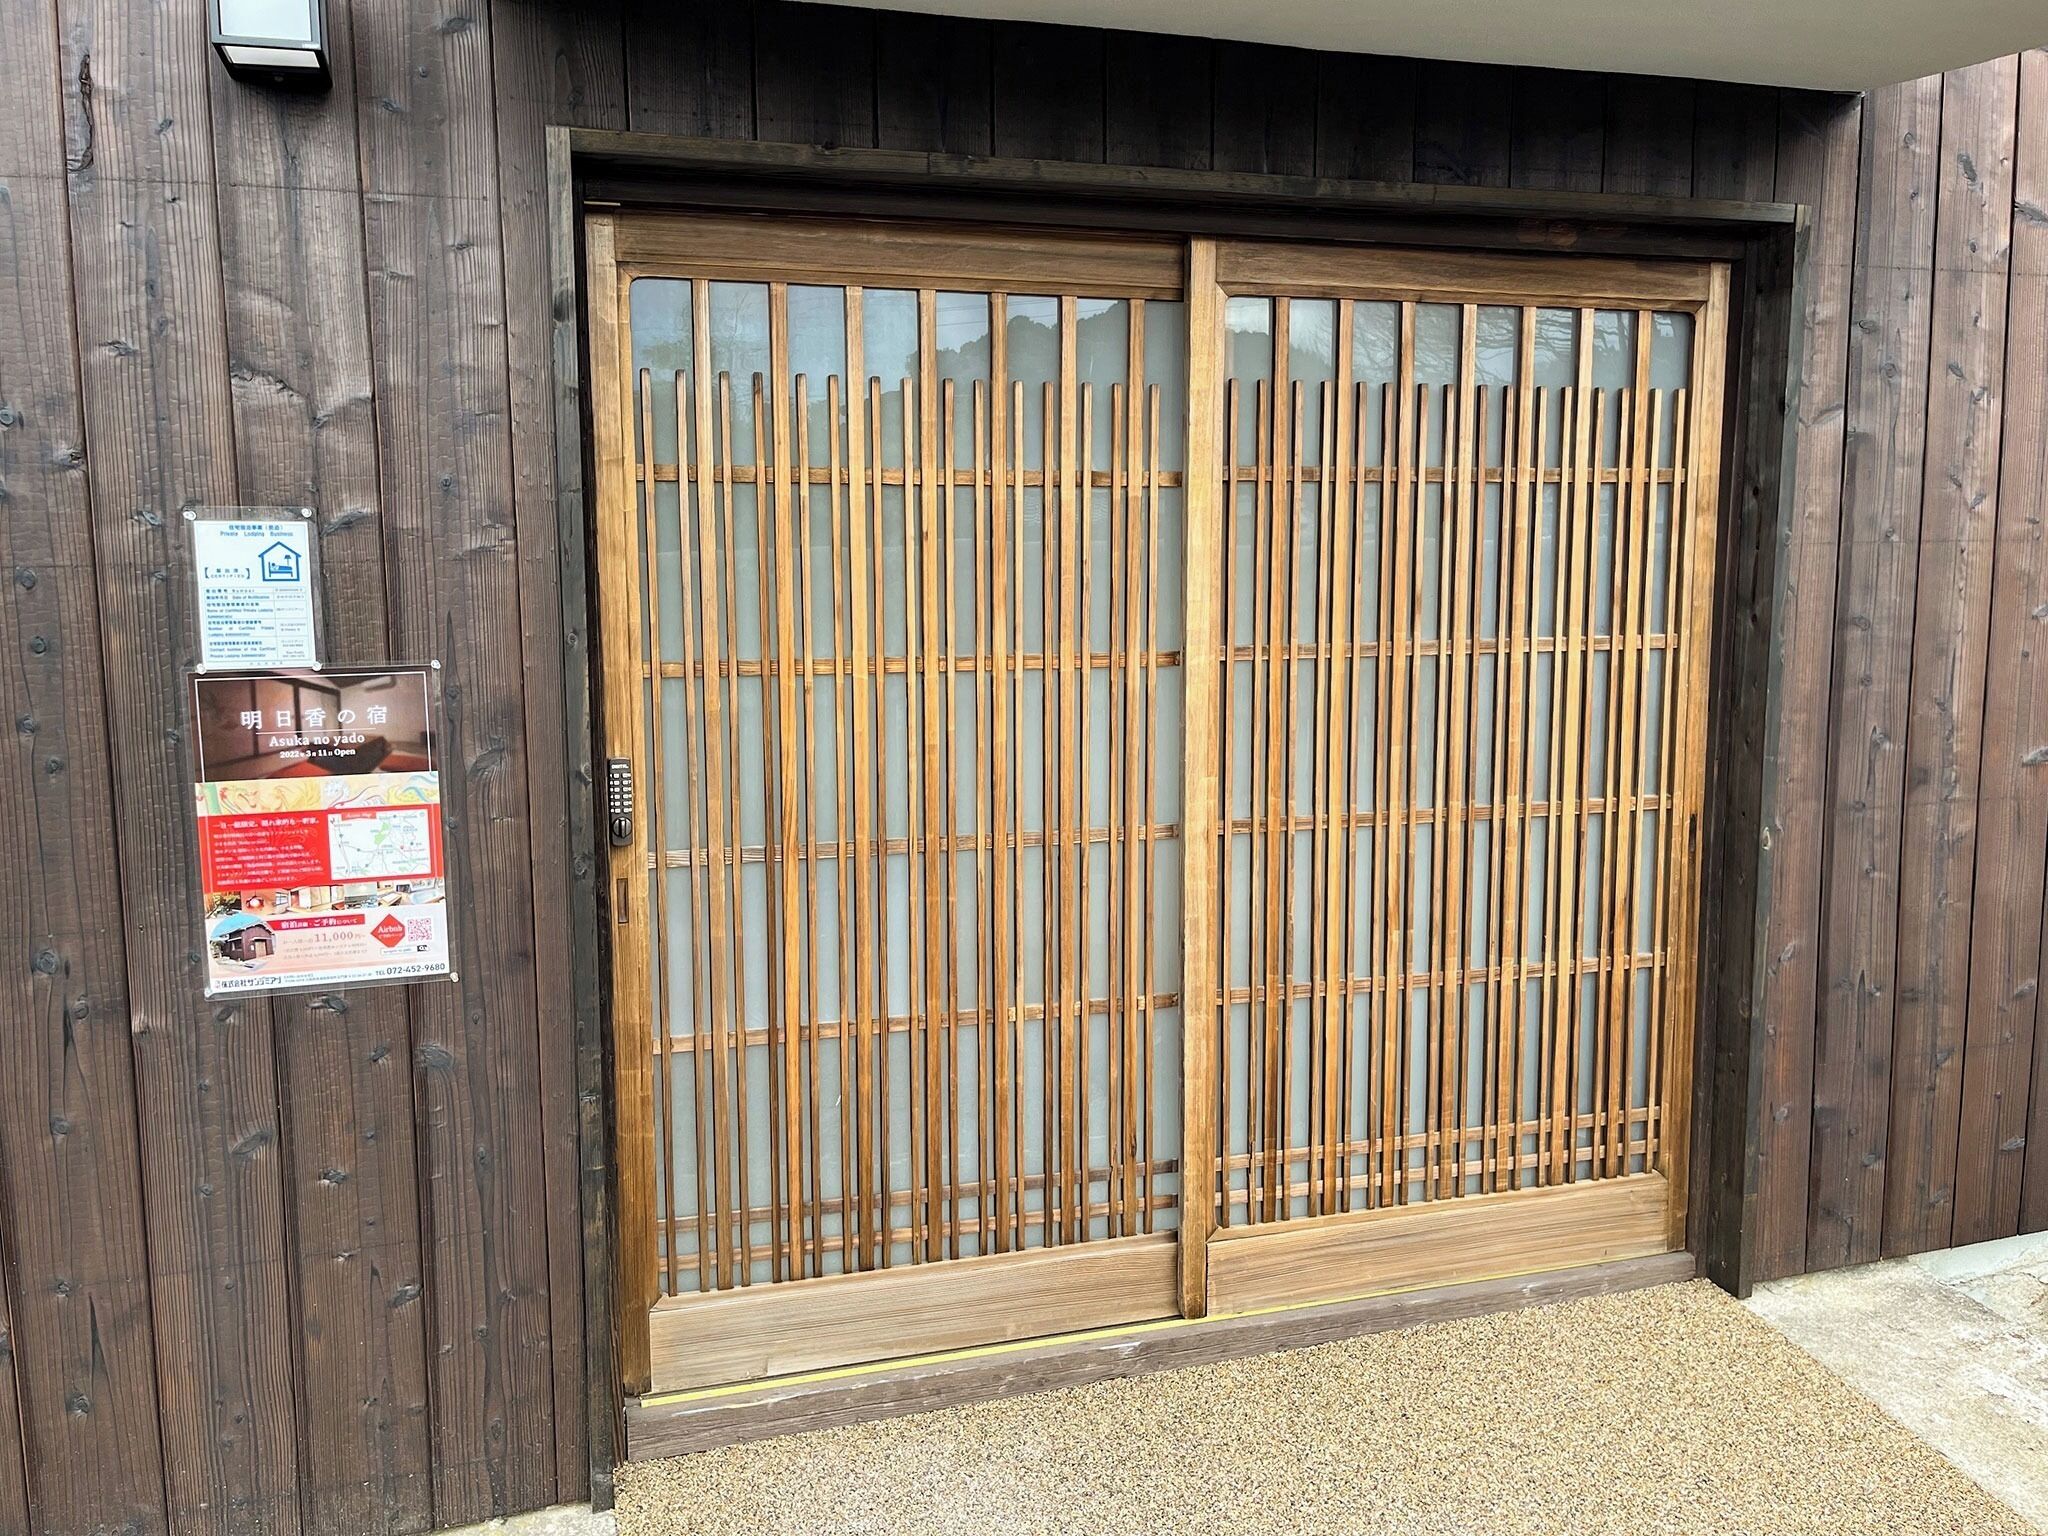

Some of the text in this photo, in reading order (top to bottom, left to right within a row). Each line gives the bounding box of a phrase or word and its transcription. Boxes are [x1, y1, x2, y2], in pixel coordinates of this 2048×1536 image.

[240, 705, 387, 730] 明日香の宿
[269, 733, 365, 748] Asuka no yado
[334, 748, 356, 758] Open
[378, 925, 403, 933] Airbnb
[387, 963, 446, 975] 072-452-9680
